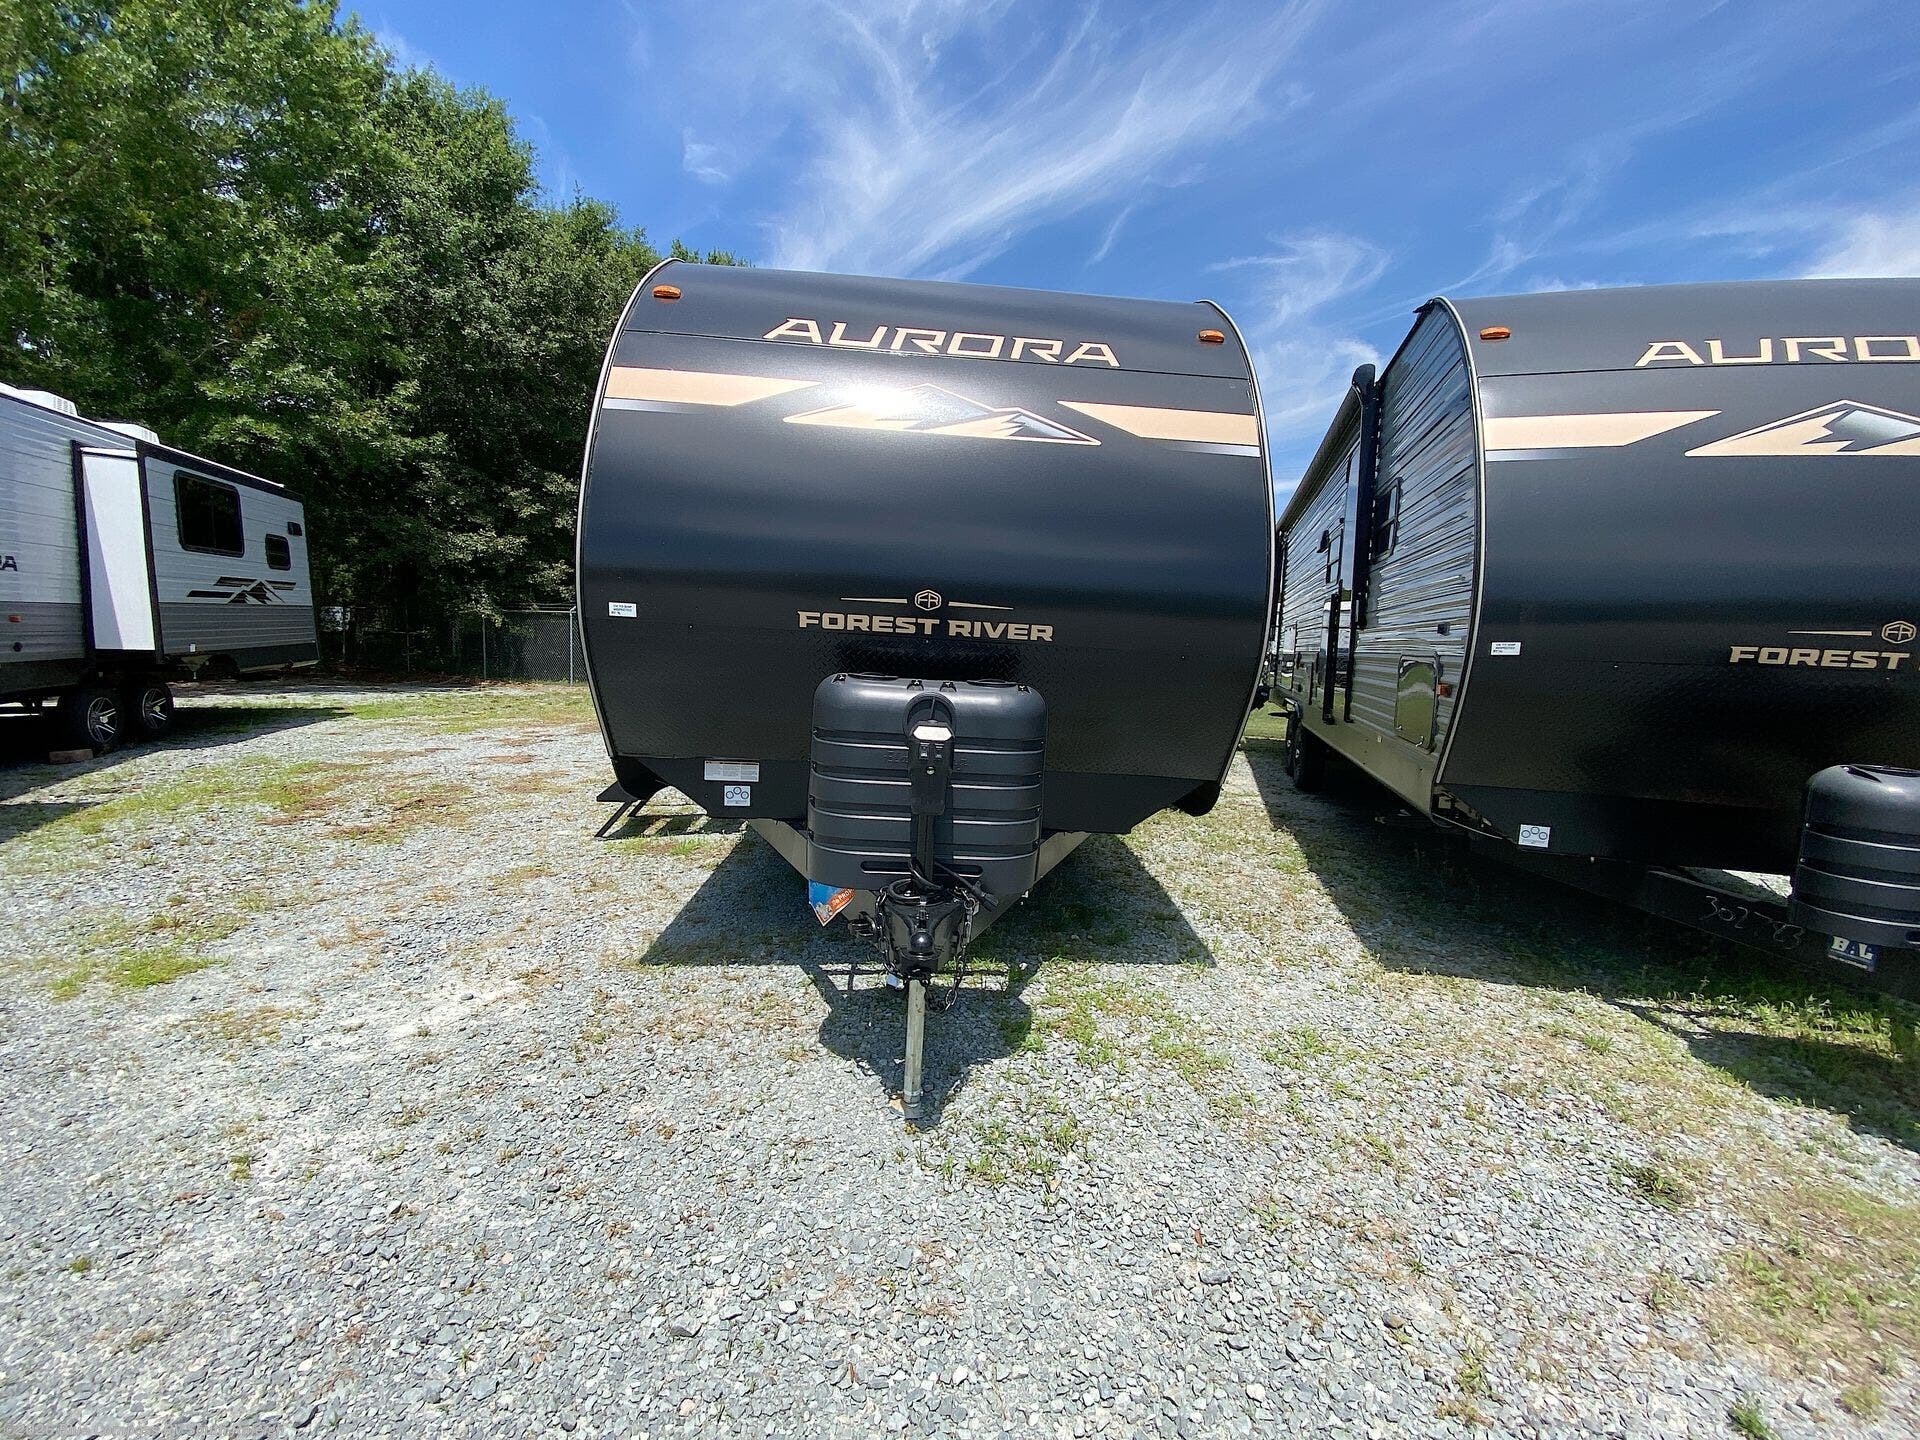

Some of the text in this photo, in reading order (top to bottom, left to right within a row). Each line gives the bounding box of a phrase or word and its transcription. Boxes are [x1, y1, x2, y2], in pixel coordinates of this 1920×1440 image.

[762, 317, 1121, 367] AURORA
[1634, 336, 1920, 367] AURO
[797, 611, 1054, 641] FOREST RIVER
[1729, 645, 1910, 670] FOREST
